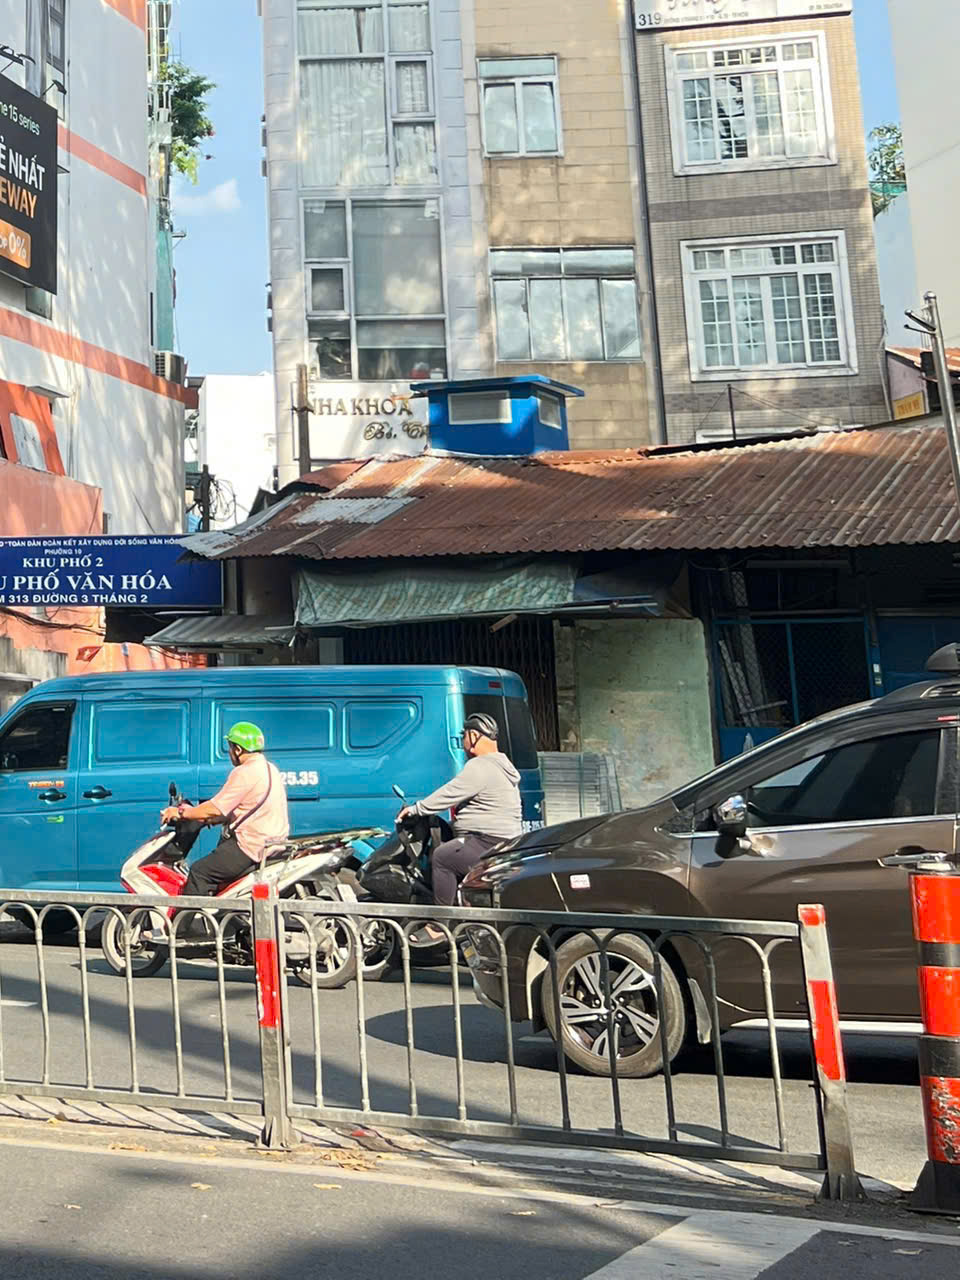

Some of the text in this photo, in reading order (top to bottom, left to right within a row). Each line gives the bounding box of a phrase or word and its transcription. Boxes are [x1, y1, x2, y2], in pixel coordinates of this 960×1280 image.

[638, 13, 662, 26] 319
[8, 106, 18, 123] 15
[18, 111, 40, 136] series
[8, 148, 46, 192] NHẤT
[8, 230, 27, 261] 0%
[351, 397, 413, 416] KHOA
[63, 538, 77, 546] KẾT
[149, 537, 164, 545] VĂN
[22, 554, 104, 568] KHU PHỐ 2
[12, 568, 60, 591] PHỐ
[66, 571, 115, 591] VĂN
[120, 570, 173, 590] HÓA
[8, 594, 29, 603] 313
[32, 593, 78, 604] ĐƯỜNG
[81, 594, 89, 603] 3
[92, 592, 137, 604] THÁNG
[140, 594, 148, 603] 2
